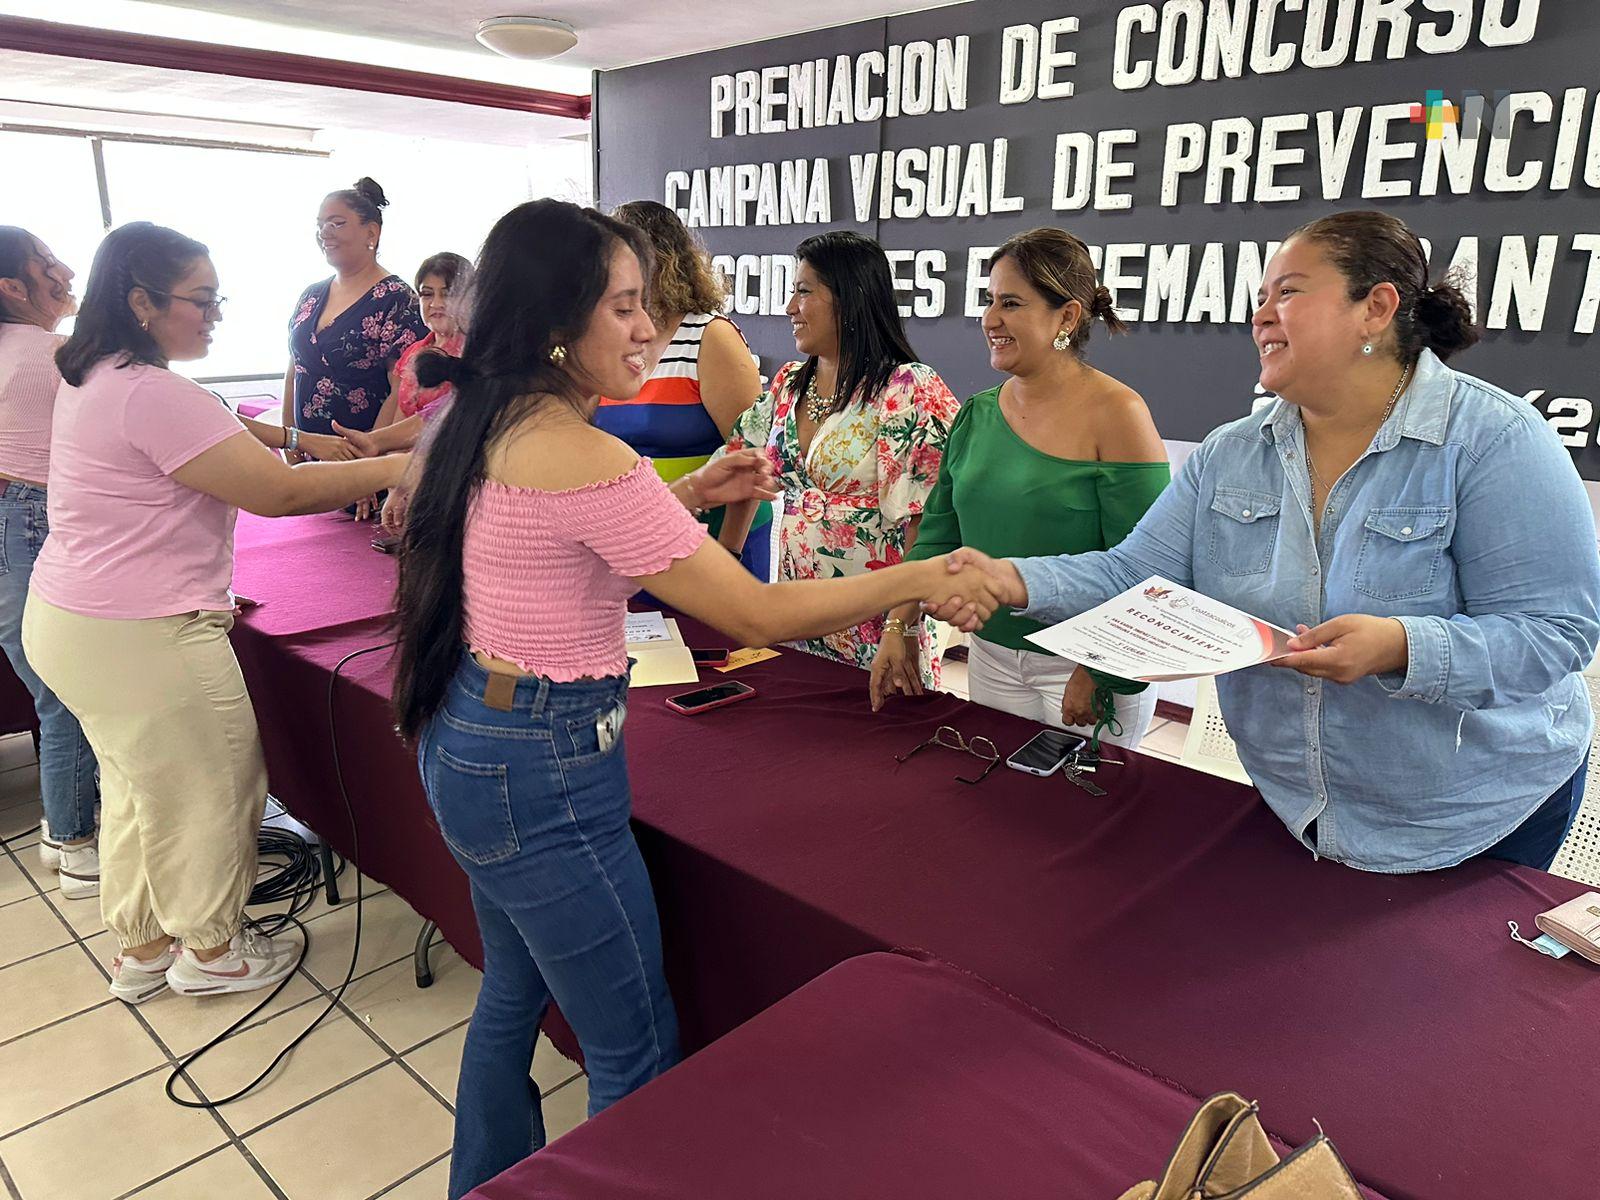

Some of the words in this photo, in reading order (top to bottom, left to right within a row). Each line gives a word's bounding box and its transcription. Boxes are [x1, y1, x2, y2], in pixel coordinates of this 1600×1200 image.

[711, 35, 969, 138] PREMIACION
[1000, 16, 1079, 105] DE
[1112, 0, 1541, 90] CONCURSO
[664, 158, 831, 228] CAMPANA
[850, 137, 1024, 222] VISUAL
[1051, 130, 1136, 210] DE
[1126, 607, 1230, 655] RECONOCIMIENTO
